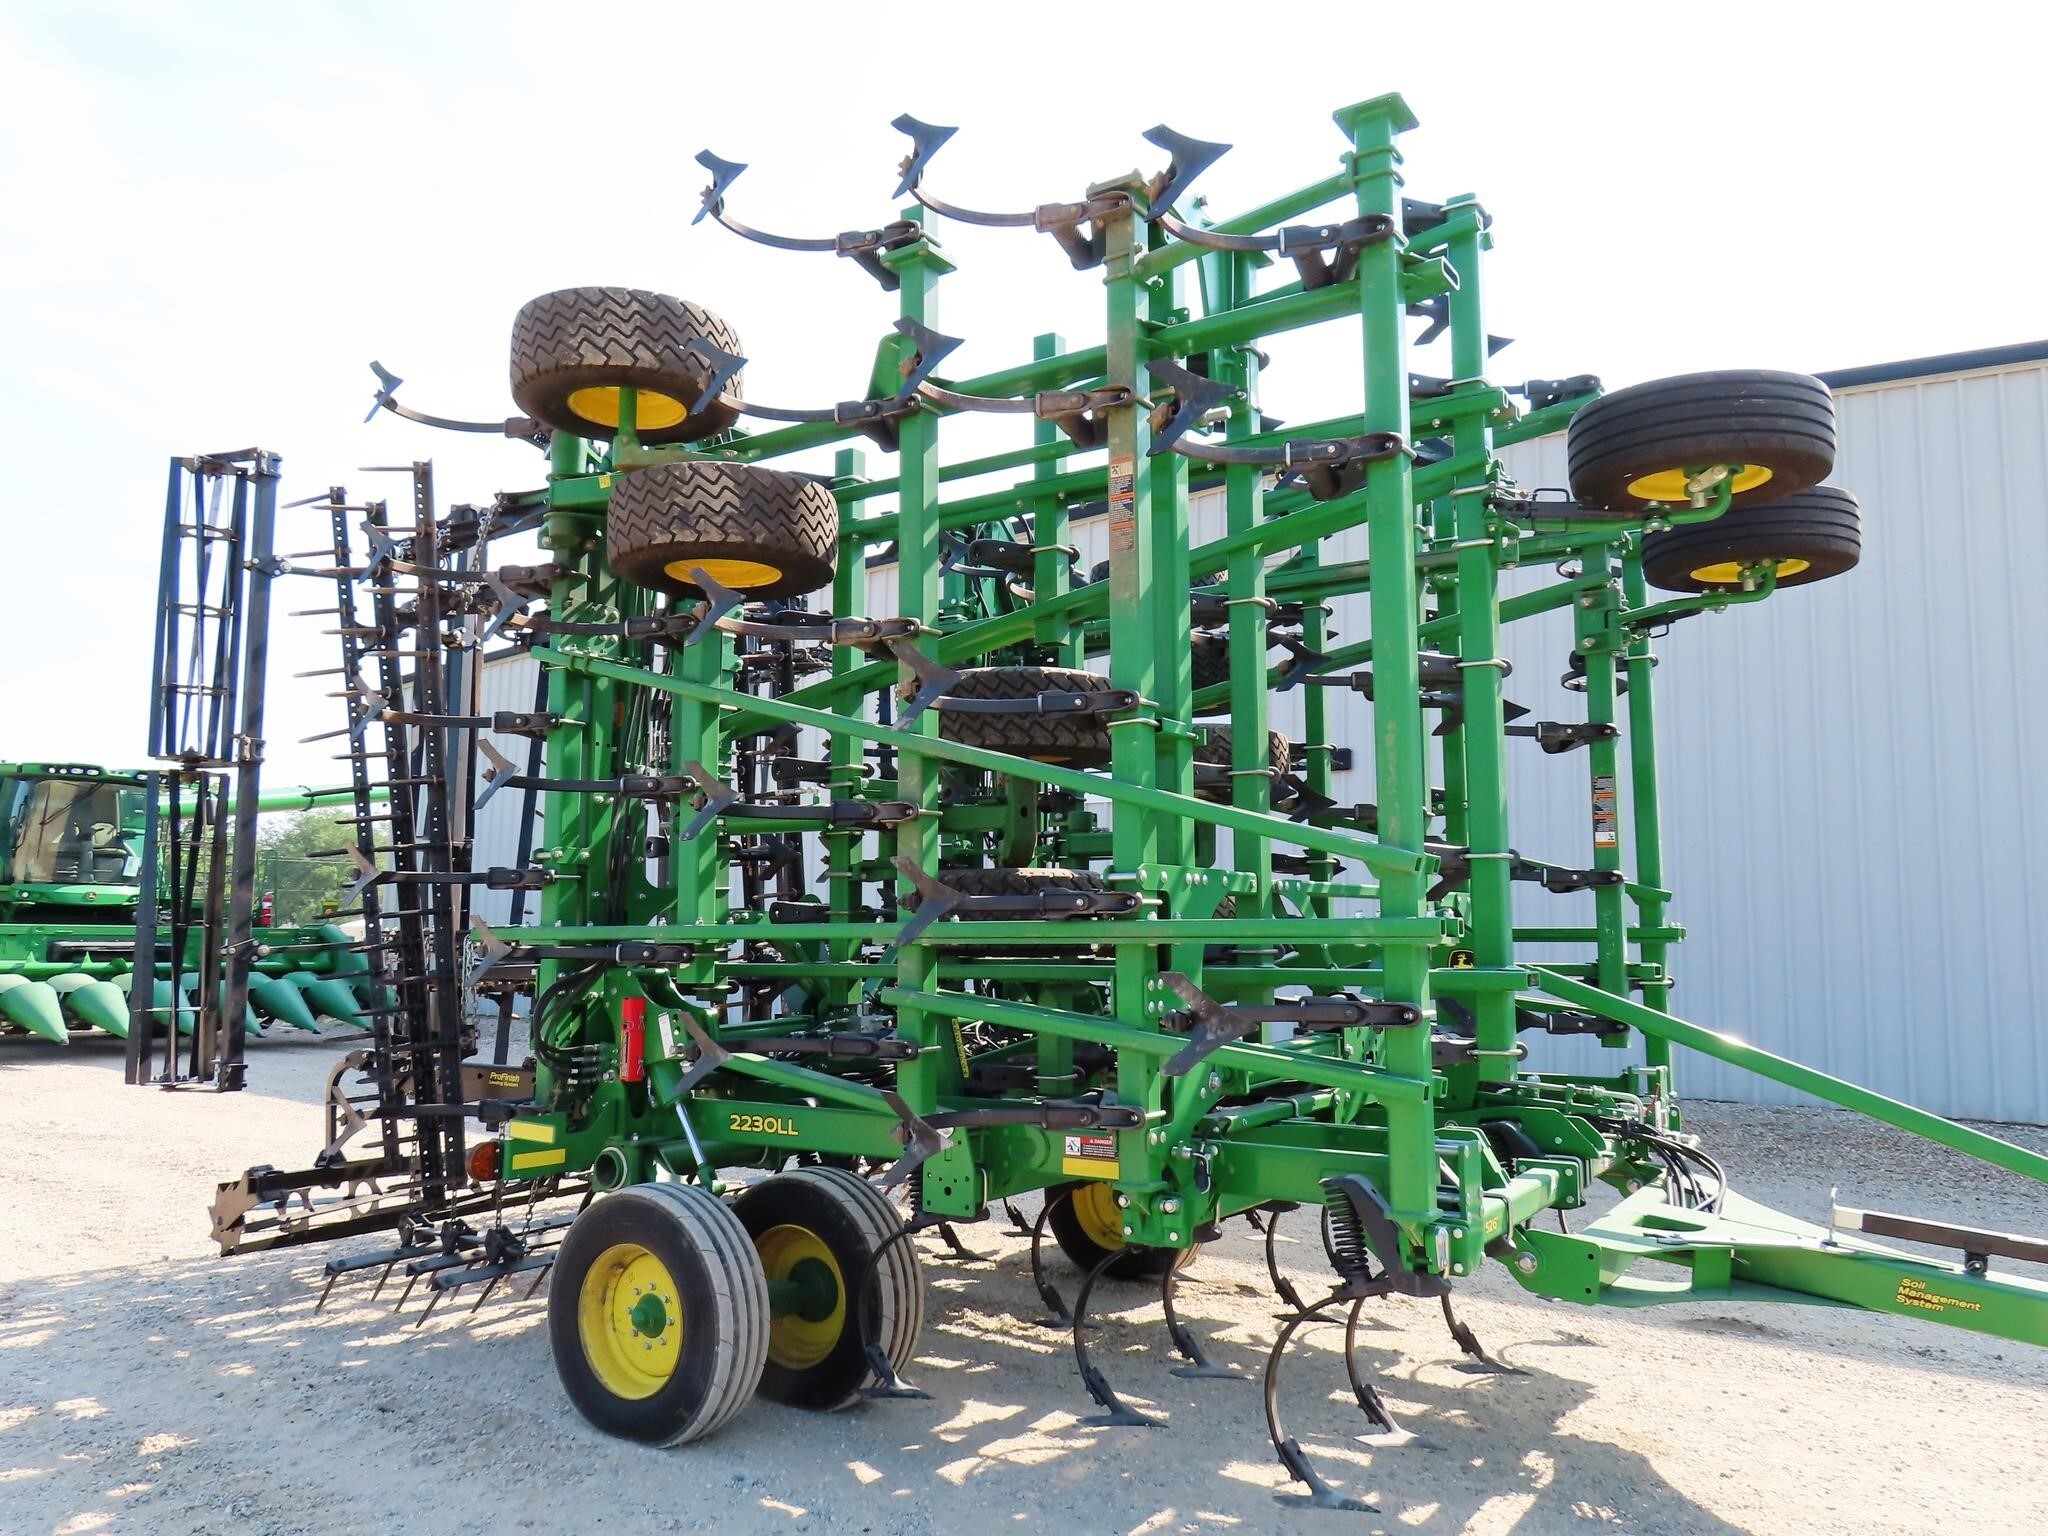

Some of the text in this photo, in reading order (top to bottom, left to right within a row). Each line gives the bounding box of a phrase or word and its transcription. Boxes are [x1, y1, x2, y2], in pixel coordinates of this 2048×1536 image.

[729, 1113, 800, 1136] 2230LL
[1901, 1278, 1926, 1290] Soil
[1896, 1294, 1945, 1312] System
[1898, 1286, 1982, 1312] Management
